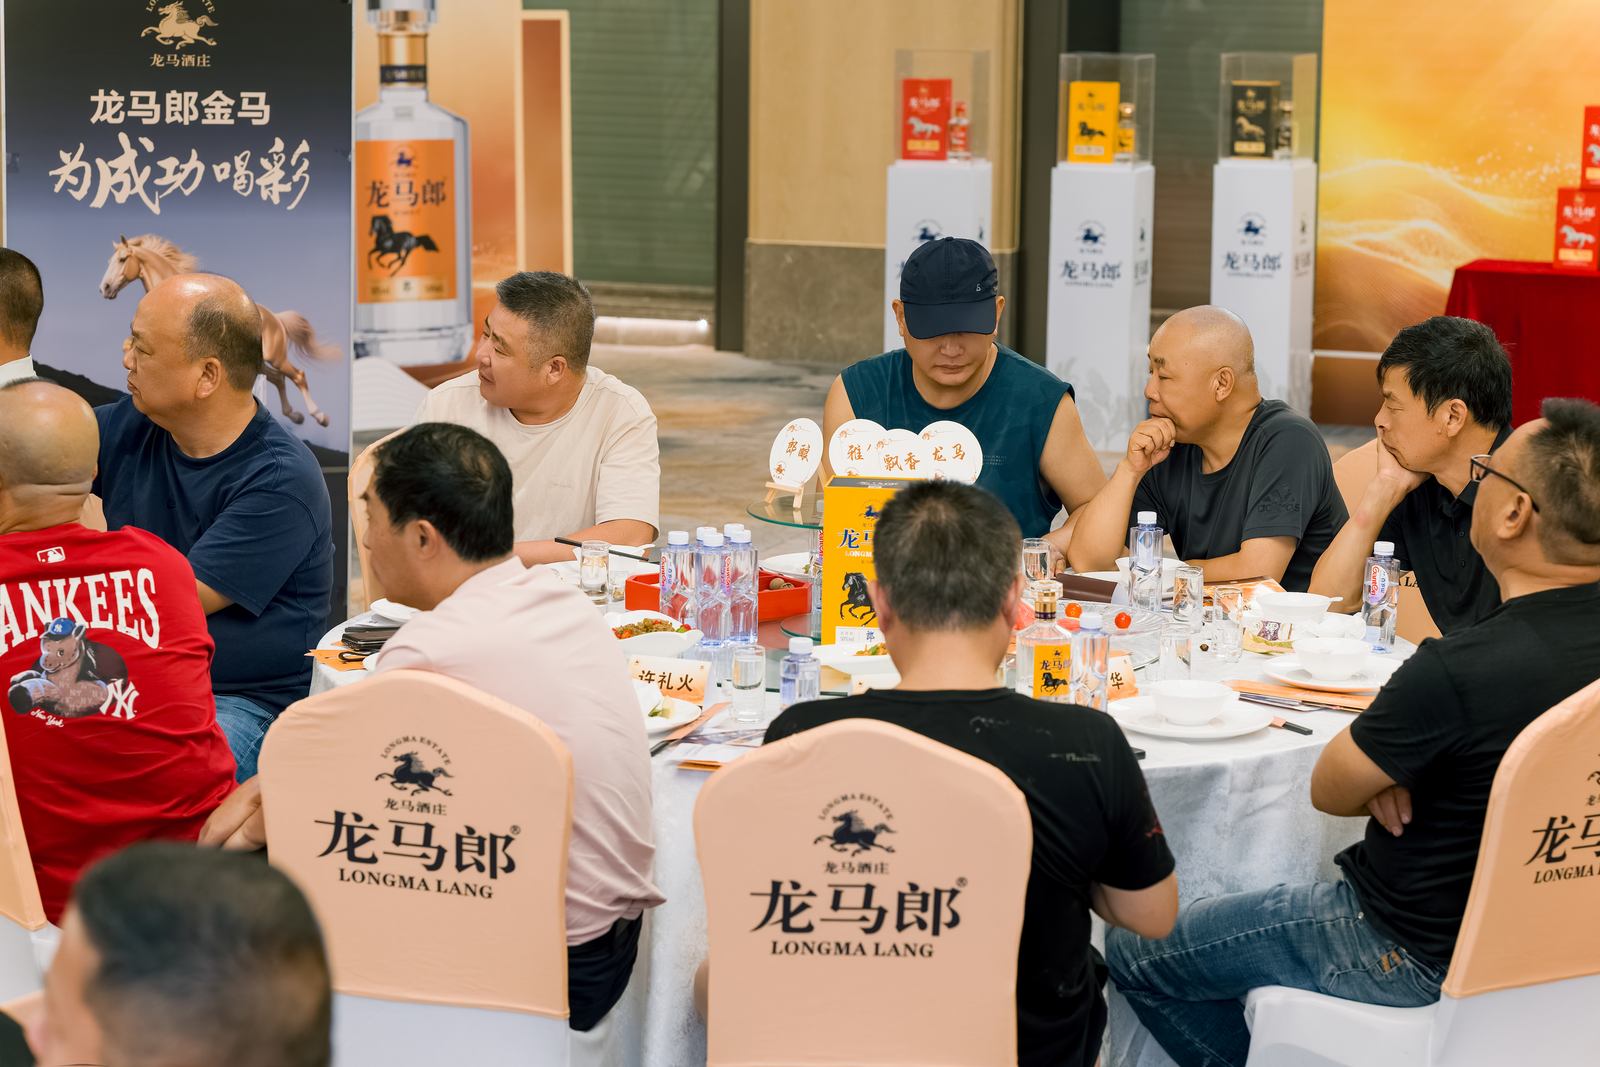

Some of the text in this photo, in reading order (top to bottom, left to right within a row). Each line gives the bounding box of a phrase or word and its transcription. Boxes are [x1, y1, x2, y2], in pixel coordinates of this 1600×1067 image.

[150, 53, 211, 67] 龙马酒庄
[90, 90, 271, 126] 龙马郎金马
[48, 131, 311, 215] 为成功喝彩
[366, 178, 446, 209] 龙马郎
[384, 798, 447, 816] 龙马酒庄
[314, 810, 516, 880] 龙马郎
[339, 868, 494, 899] LONGMA LANG
[824, 861, 889, 875] 龙马酒庄
[1534, 864, 1594, 884] LONGMA
[750, 880, 961, 936] 龙马郎
[770, 940, 934, 957] LONGMA LANG
